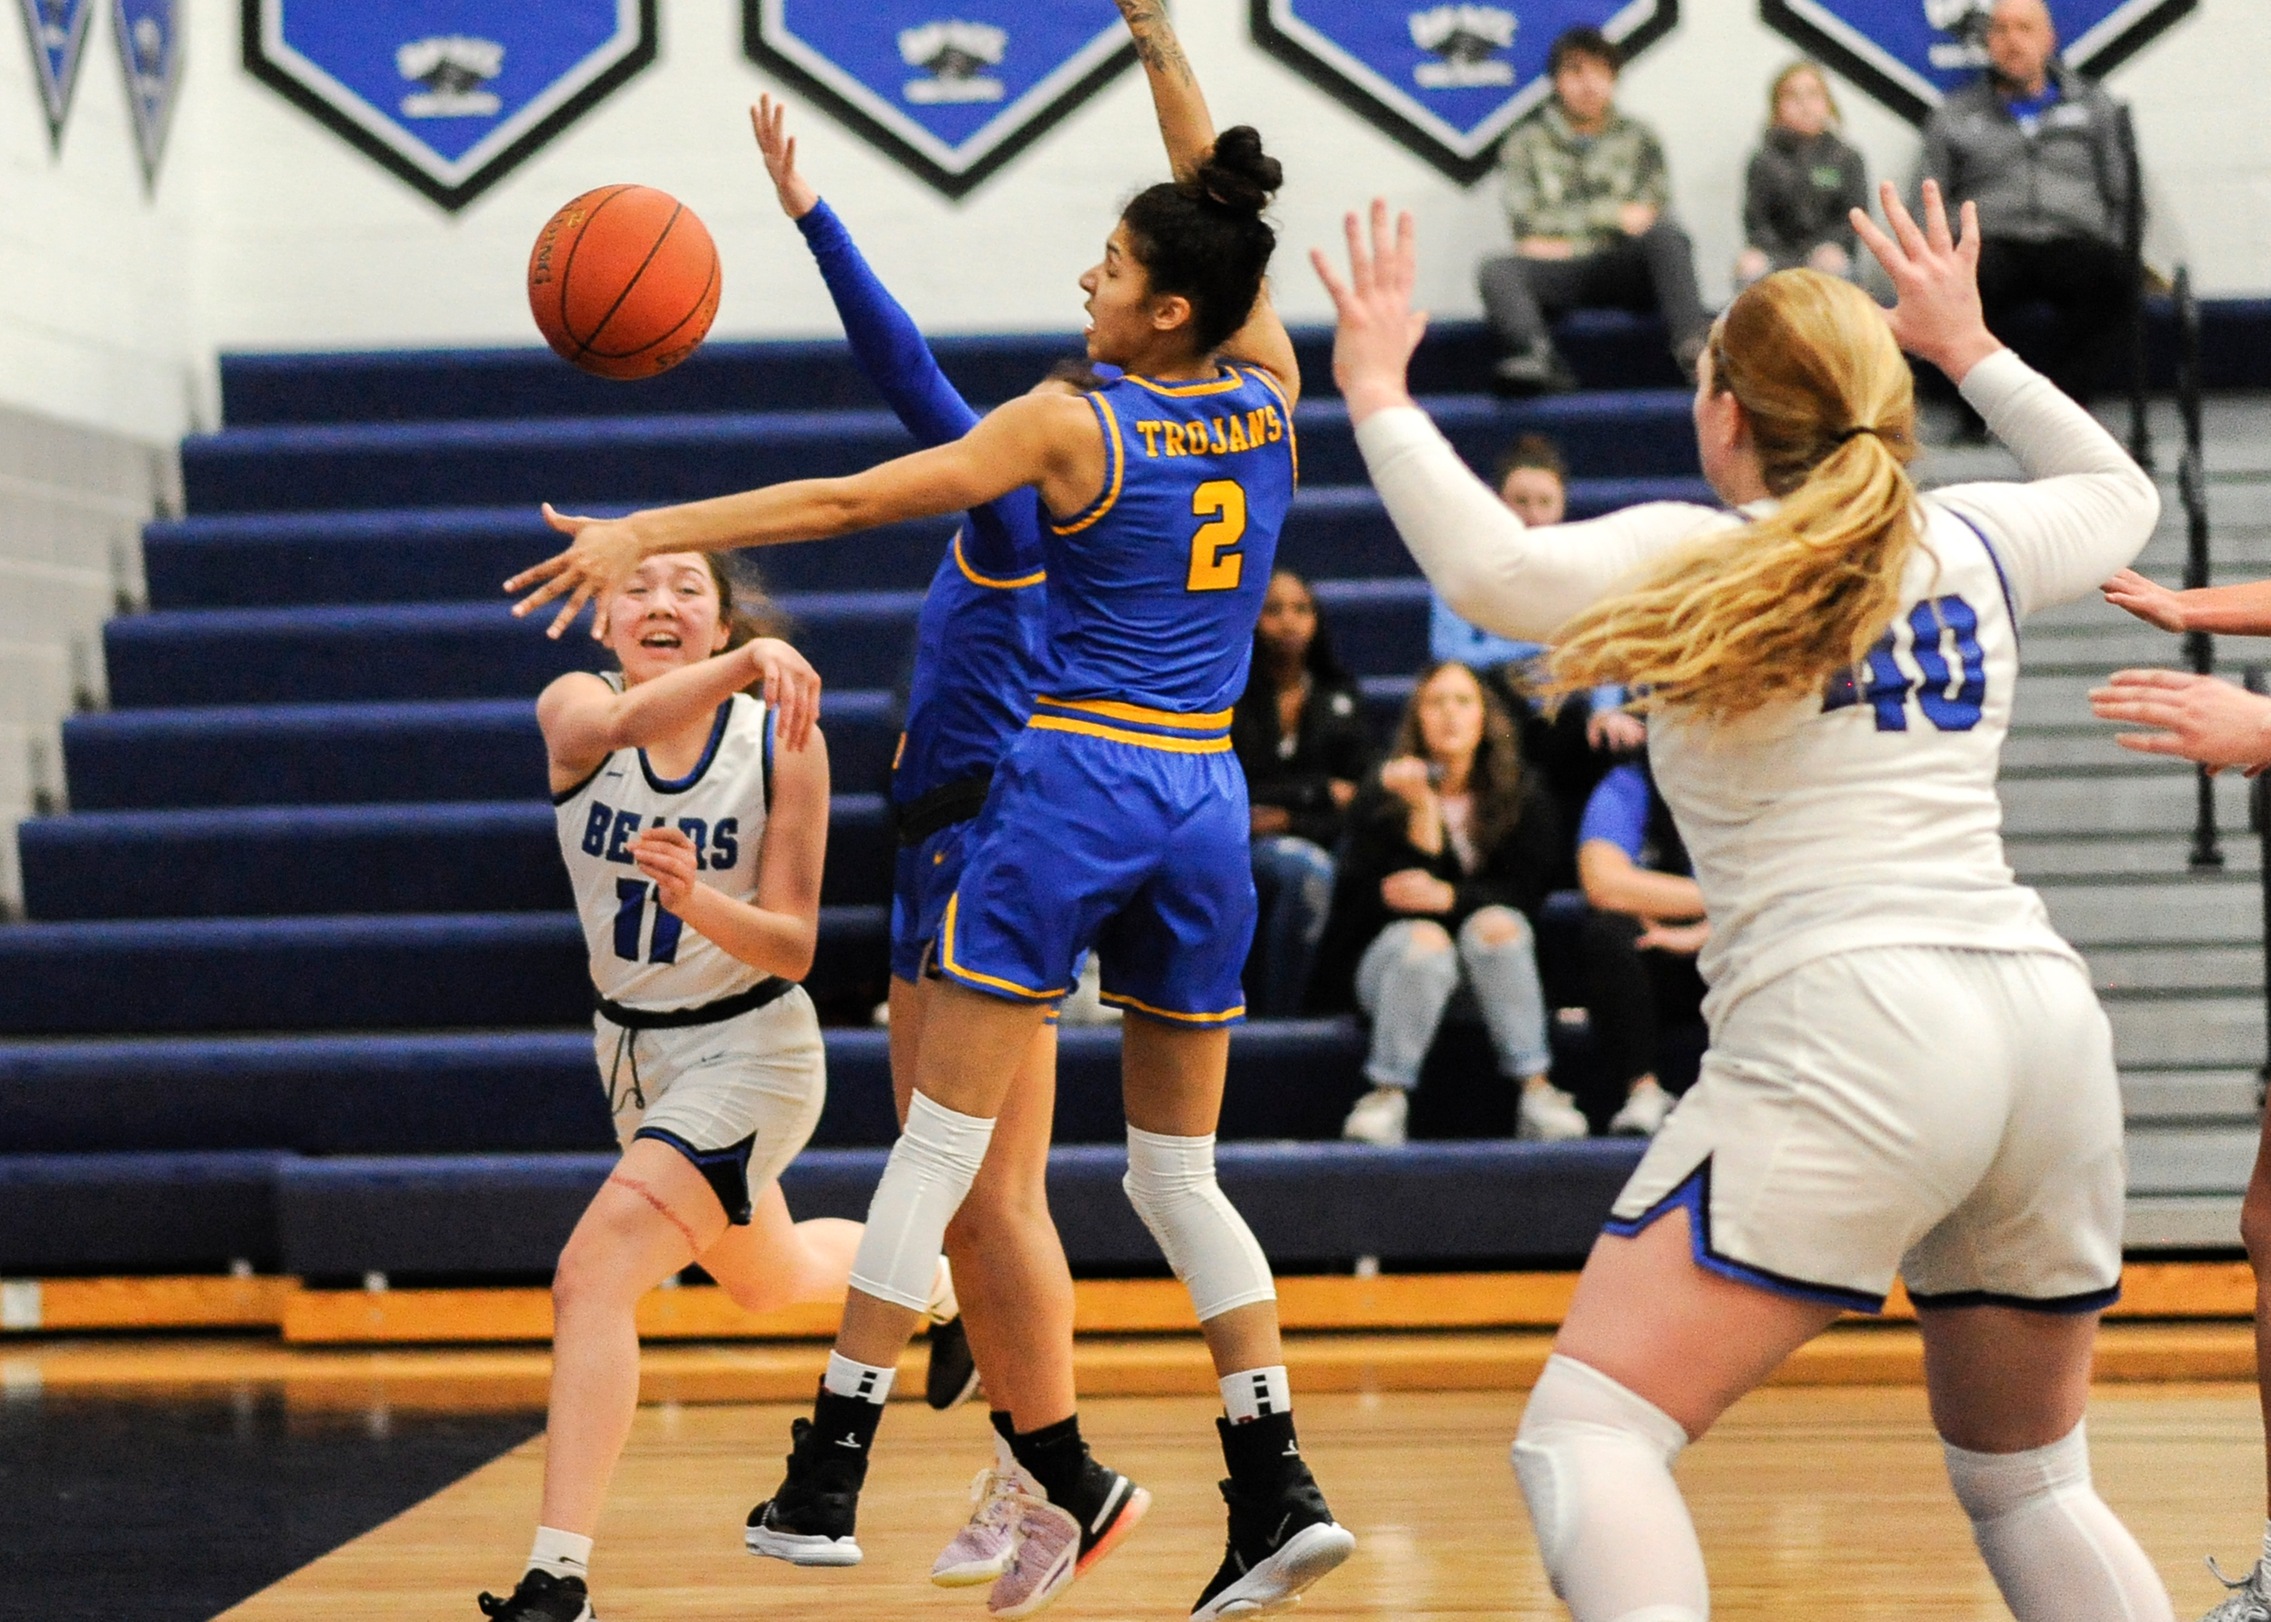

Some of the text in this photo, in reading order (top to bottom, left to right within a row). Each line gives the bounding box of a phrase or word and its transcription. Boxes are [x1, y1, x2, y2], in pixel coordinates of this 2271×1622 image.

[1136, 405, 1282, 457] TROJANS
[1186, 477, 1247, 592] 2
[1821, 593, 1985, 732] 40
[581, 800, 739, 871] BERS
